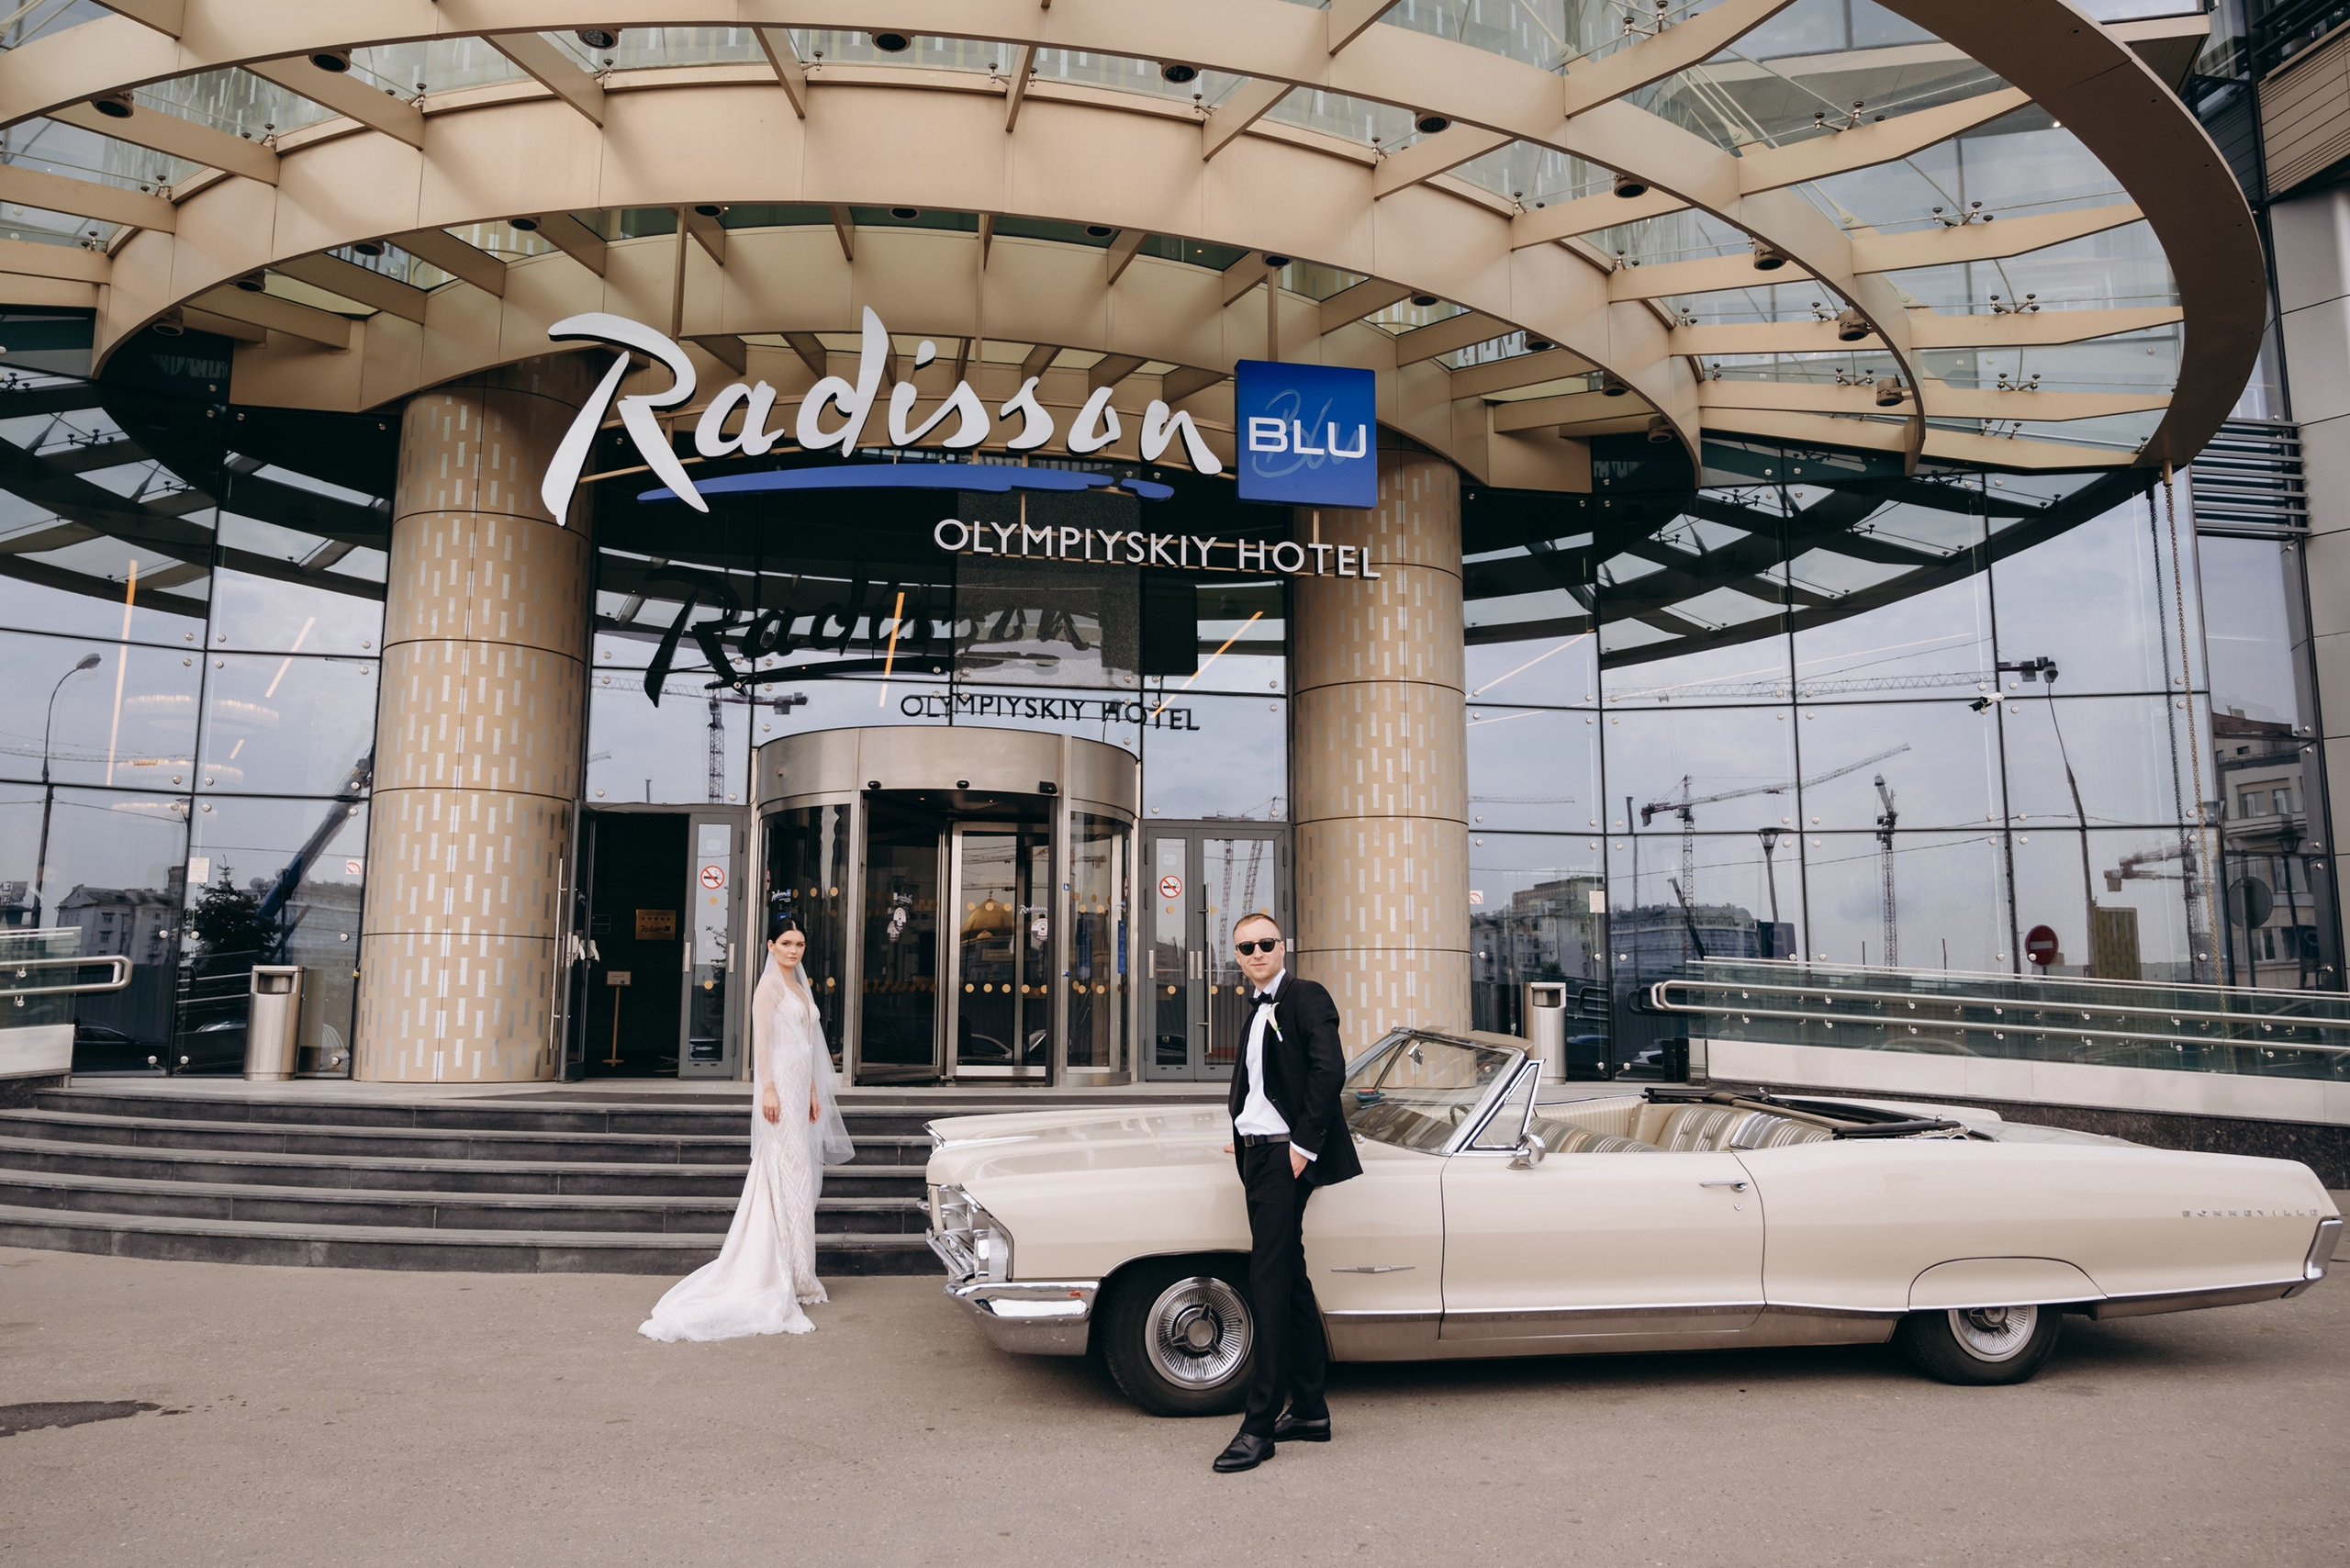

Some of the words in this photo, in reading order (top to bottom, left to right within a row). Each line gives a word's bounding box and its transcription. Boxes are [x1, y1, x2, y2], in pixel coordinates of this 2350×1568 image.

[542, 306, 1222, 527] Radisson
[1248, 417, 1367, 459] BLU
[934, 519, 1217, 566] OLYMPIYSKIY
[1238, 539, 1382, 578] HOTEL
[901, 693, 1085, 721] OLYMPIYSKIY
[1102, 700, 1200, 731] HOTEL
[2182, 1209, 2319, 1217] BONNEVILLE
